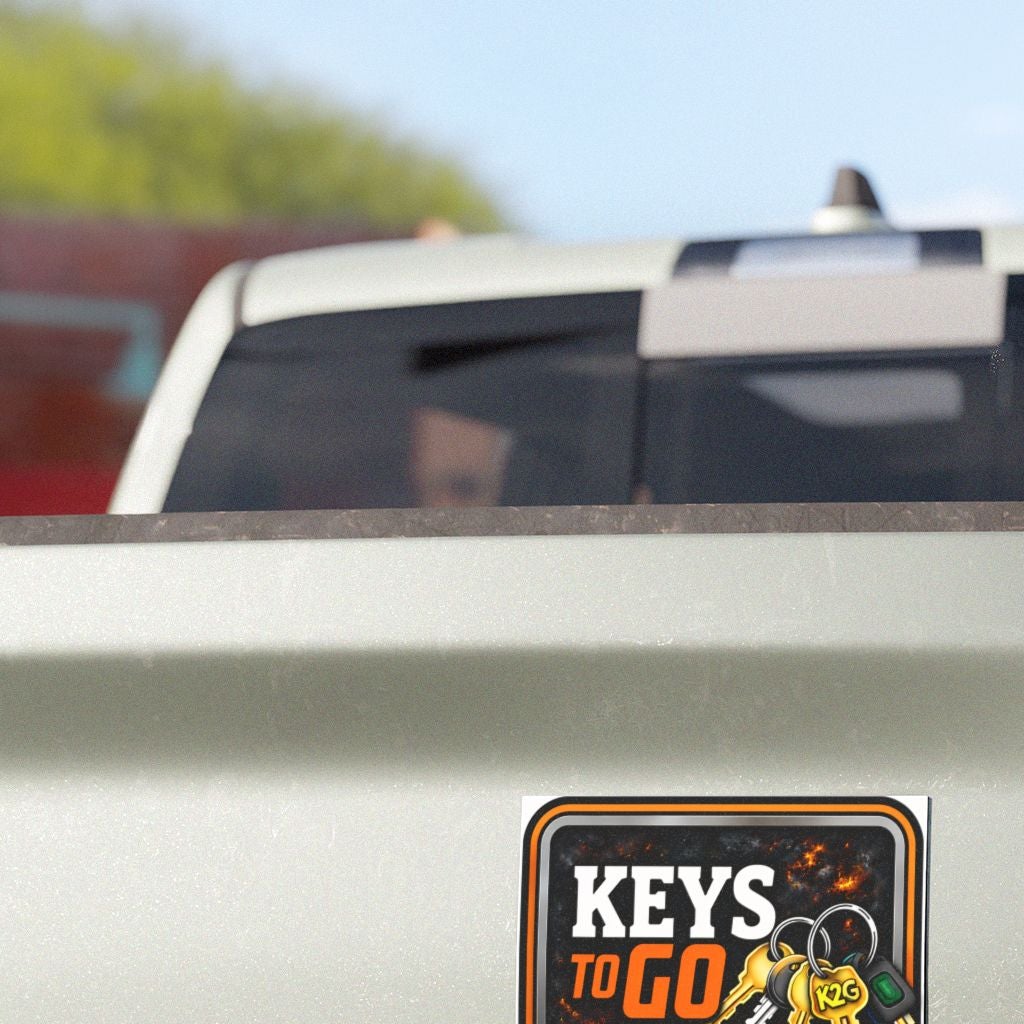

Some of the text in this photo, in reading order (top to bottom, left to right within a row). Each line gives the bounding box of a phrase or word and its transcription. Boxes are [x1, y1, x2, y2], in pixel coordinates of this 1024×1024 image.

[571, 864, 777, 940] KEYS
[570, 943, 727, 1020] TO GO
[815, 979, 860, 1012] K2G
